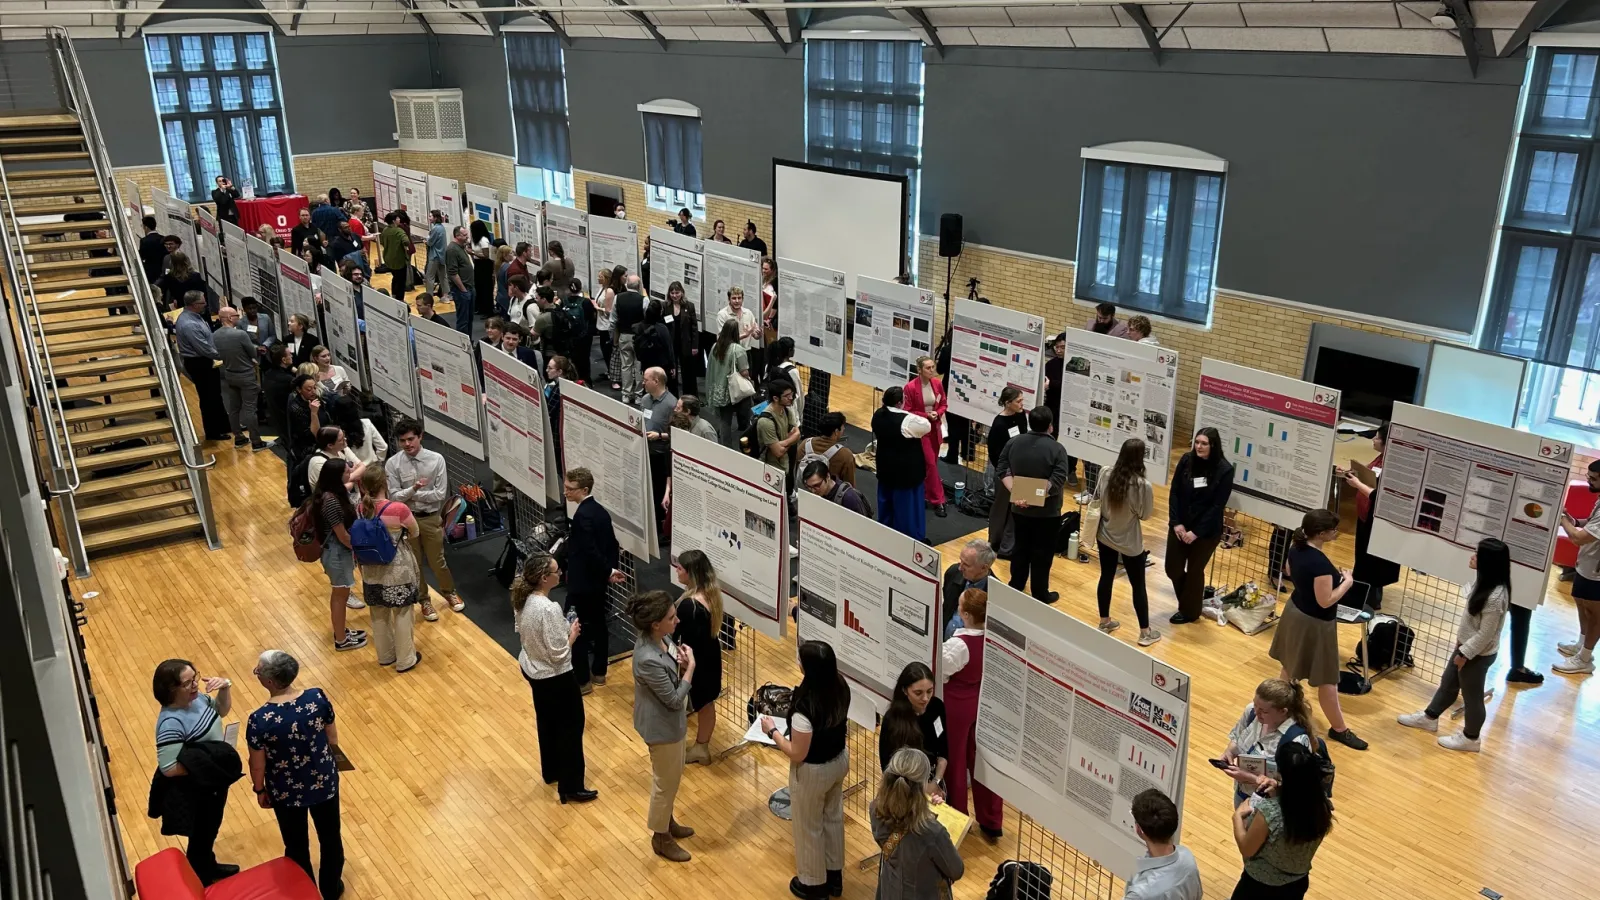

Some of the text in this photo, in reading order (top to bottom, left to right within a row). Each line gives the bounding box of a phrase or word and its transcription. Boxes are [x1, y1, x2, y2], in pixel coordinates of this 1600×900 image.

[1323, 393, 1336, 404] 32
[635, 416, 641, 426] 4
[1553, 444, 1567, 457] 31
[775, 474, 781, 487] 3
[928, 553, 935, 570] 2
[1175, 677, 1181, 693] 1
[1133, 704, 1151, 718] NEWS
[1137, 699, 1151, 711] FOX
[1152, 716, 1178, 737] NBC
